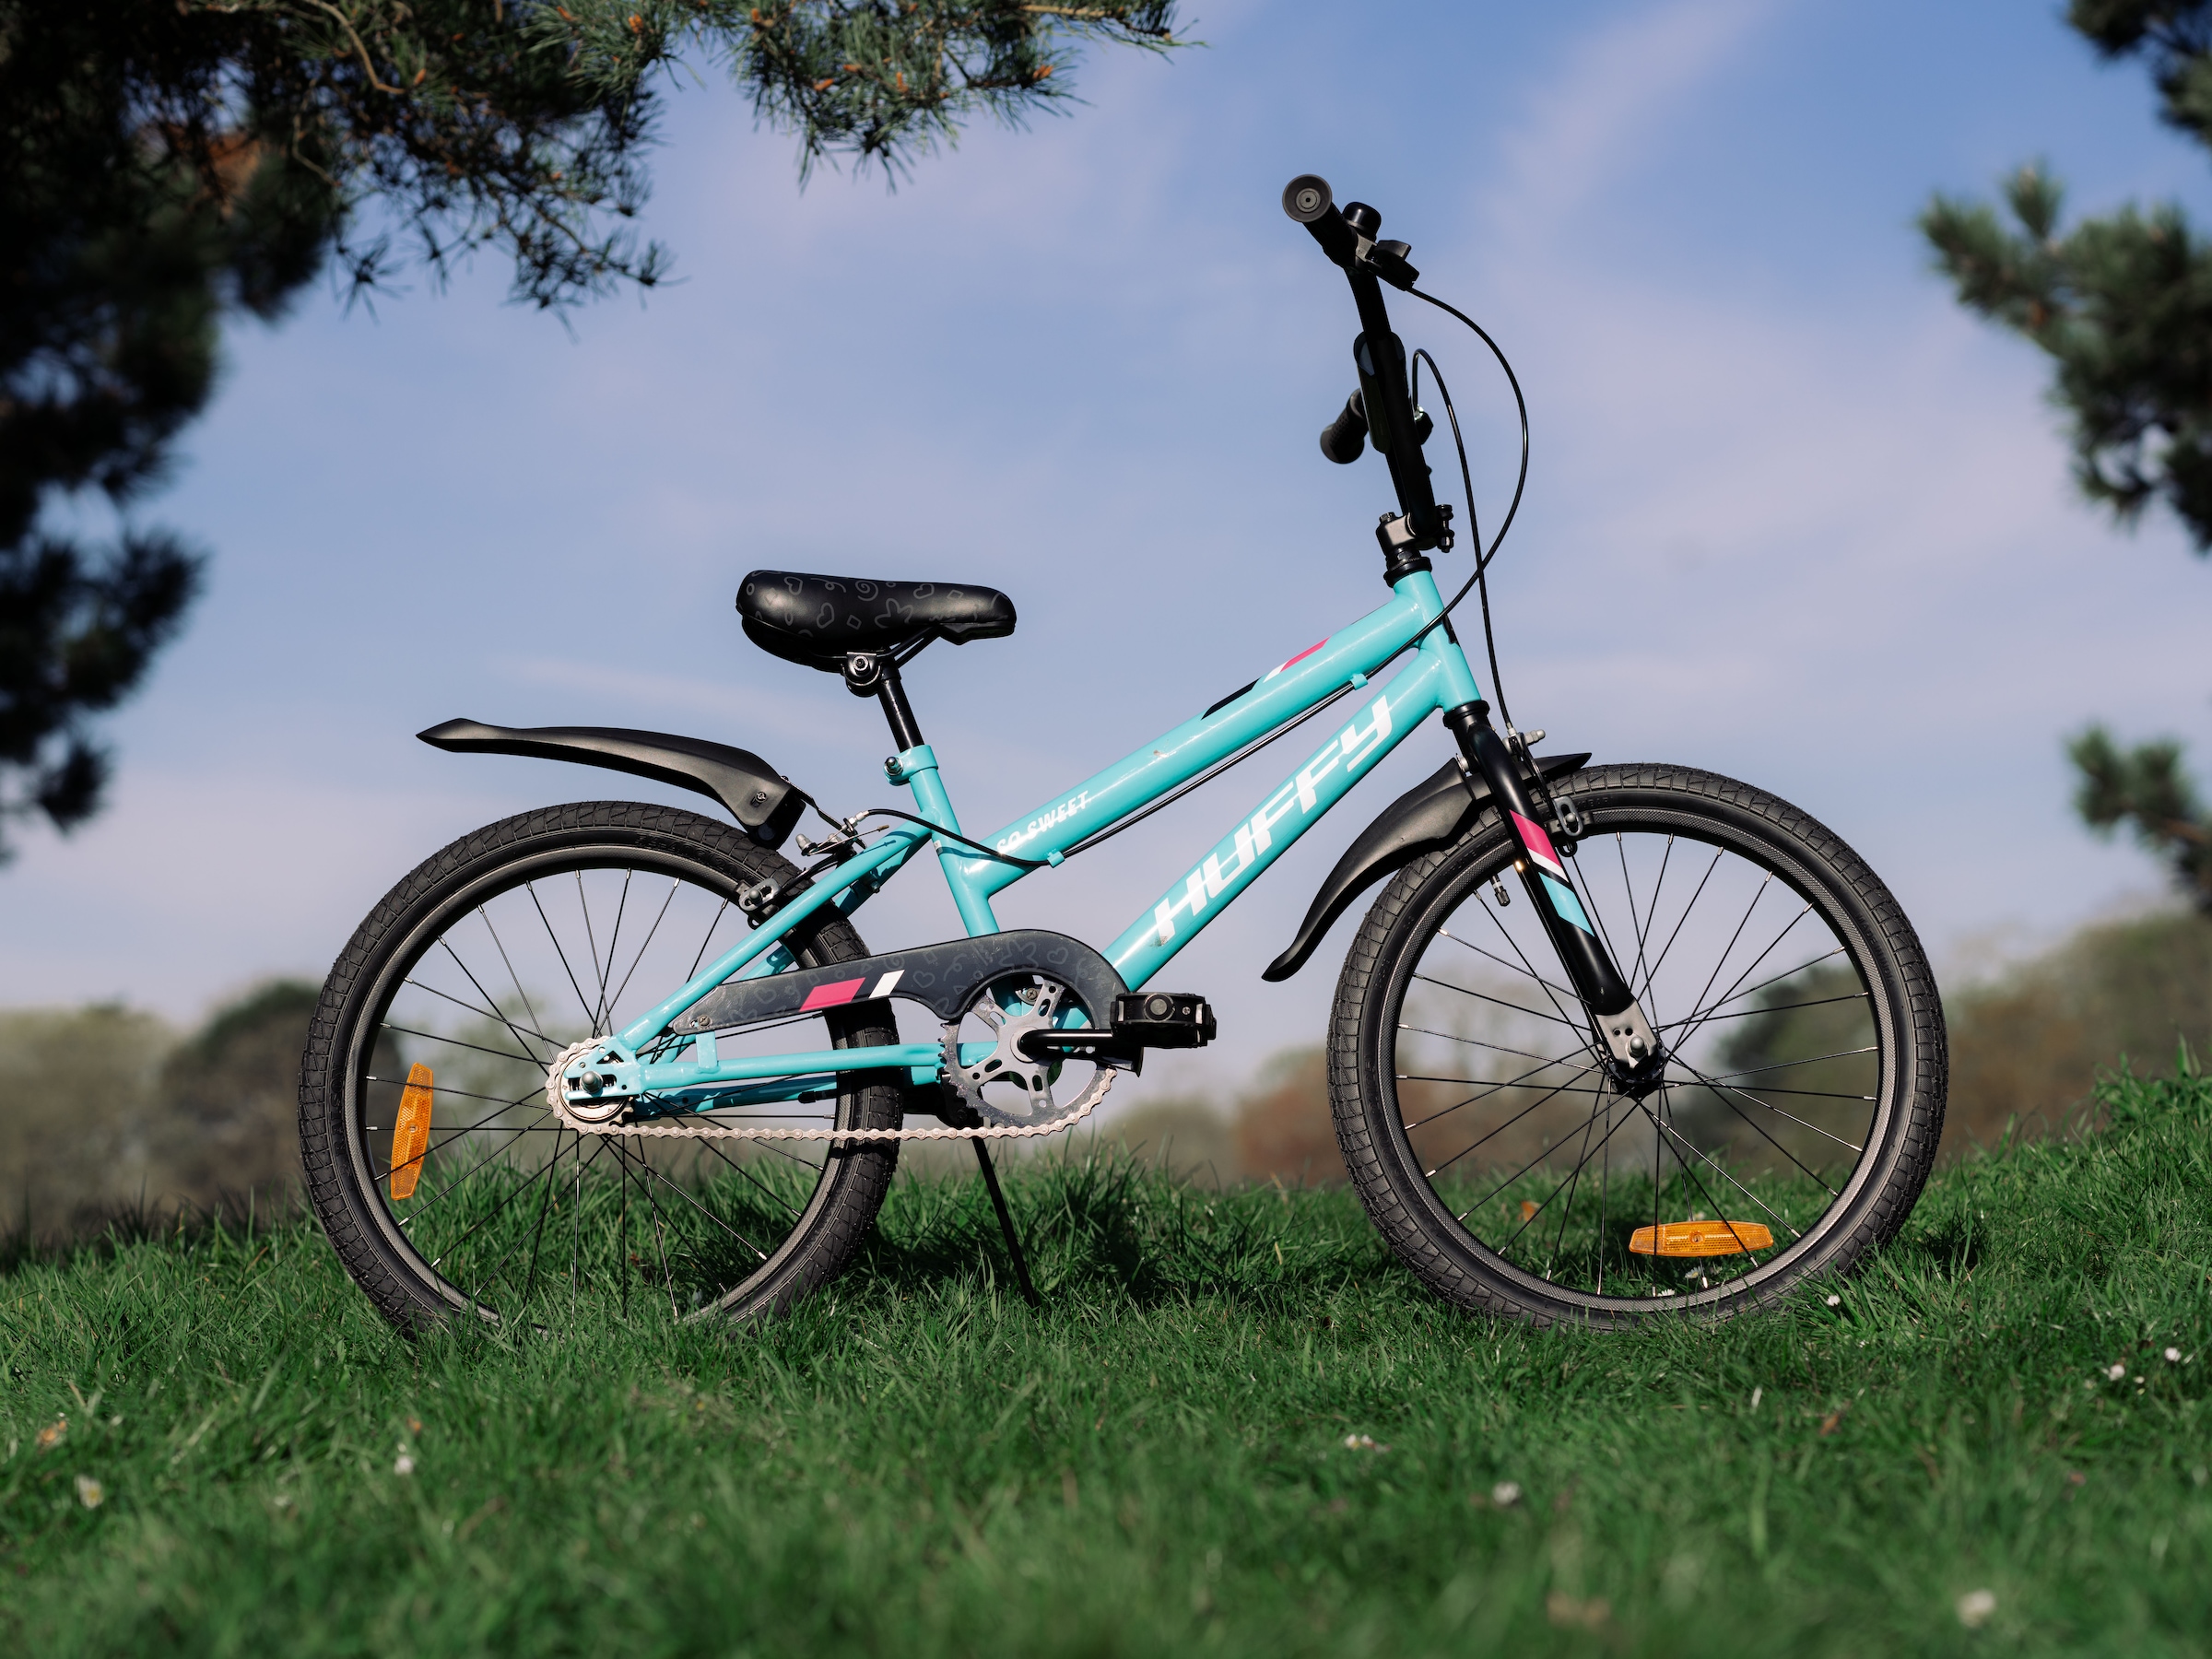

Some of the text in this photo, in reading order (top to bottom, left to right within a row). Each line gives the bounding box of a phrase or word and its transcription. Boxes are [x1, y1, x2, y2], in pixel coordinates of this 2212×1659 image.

[997, 790, 1088, 853] SO SWEET
[1154, 695, 1393, 946] HUFFY
[1854, 912, 1878, 945] MADE
[329, 1063, 347, 1156] RALSON
